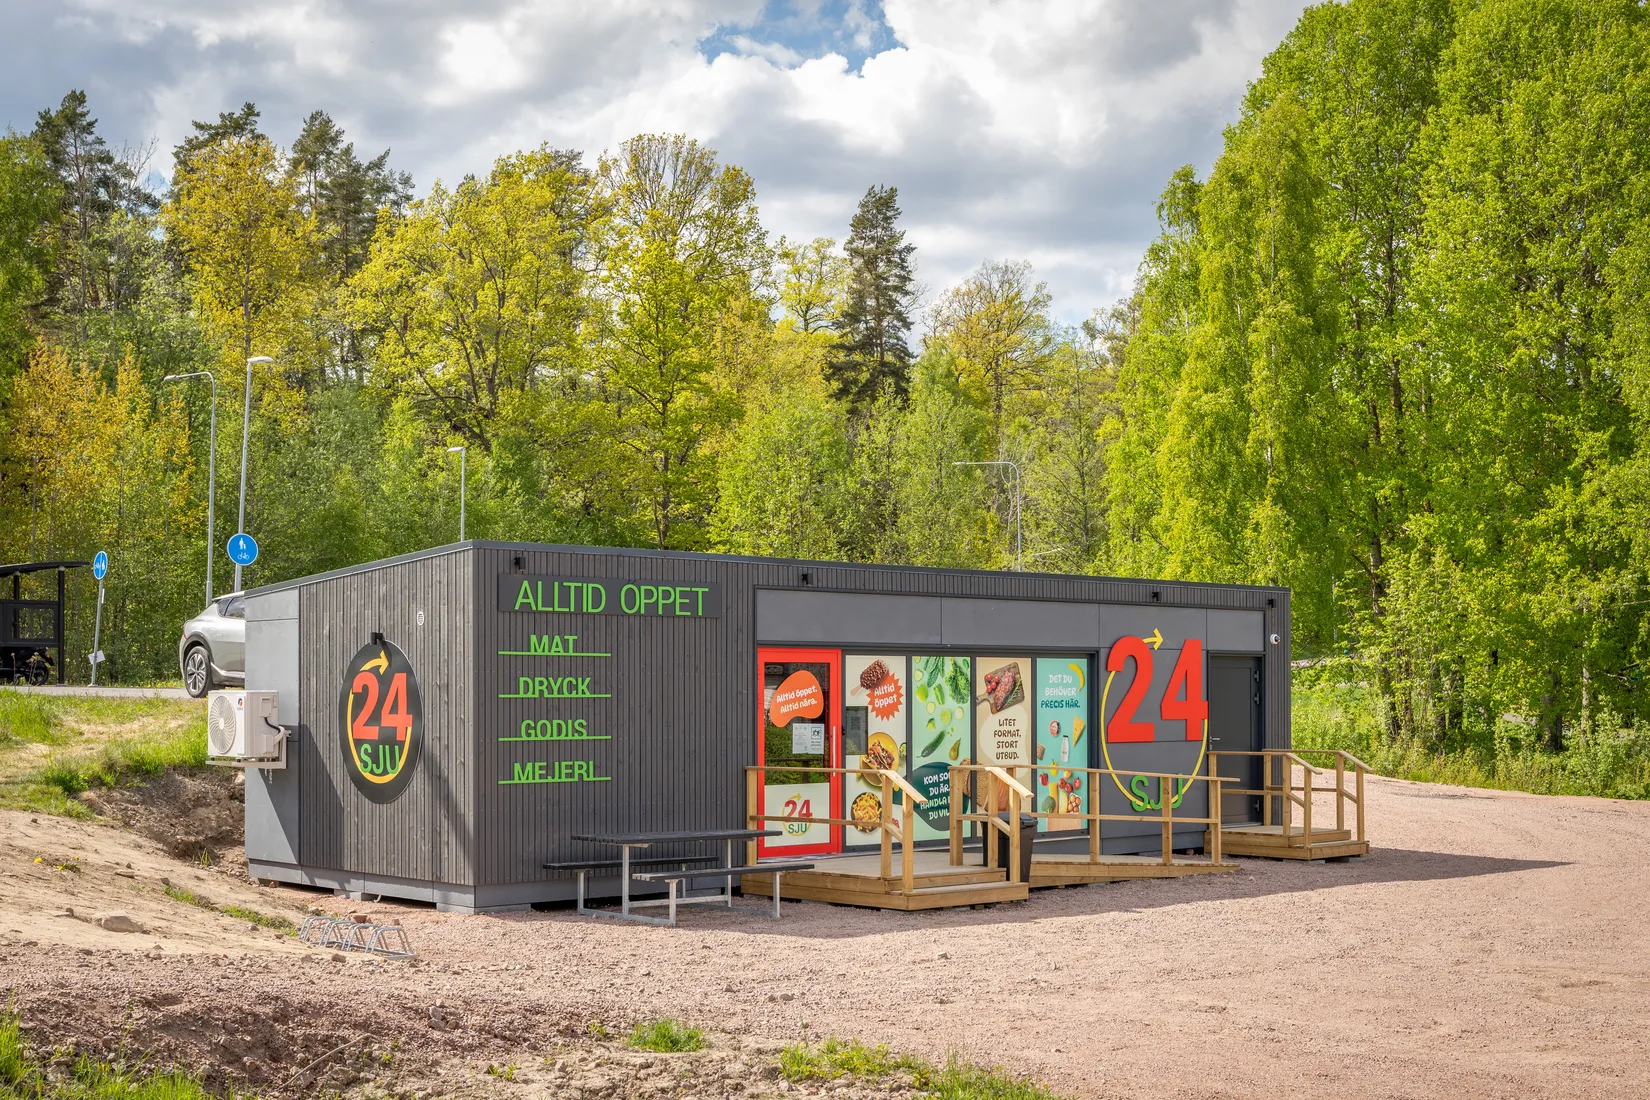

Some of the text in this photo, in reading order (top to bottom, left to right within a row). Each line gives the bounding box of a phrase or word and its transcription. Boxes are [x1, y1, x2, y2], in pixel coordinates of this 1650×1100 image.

[514, 580, 607, 613] ALLTID
[530, 634, 578, 655] MAT
[1049, 674, 1072, 684] DET DU
[519, 677, 591, 698] DRYCK
[874, 682, 894, 696] Alltid
[1045, 686, 1076, 696] BEHÖVER
[1106, 636, 1208, 743] 24
[776, 691, 794, 703] Alltid
[874, 693, 897, 708] öppet
[1040, 698, 1080, 708] PRECIS HÄR.
[353, 671, 413, 741] 24
[780, 702, 799, 714] Alltid
[998, 718, 1016, 726] LITET
[520, 719, 588, 739] GODIS
[996, 740, 1018, 748] STORT
[360, 743, 400, 774] SJU
[996, 751, 1019, 760] UTBUD.
[513, 761, 594, 782] MEJERI
[924, 772, 950, 785] KOM SO
[929, 786, 938, 796] DU
[784, 799, 812, 818] 24
[929, 808, 950, 820] DU VIL
[788, 823, 807, 834] SJU
